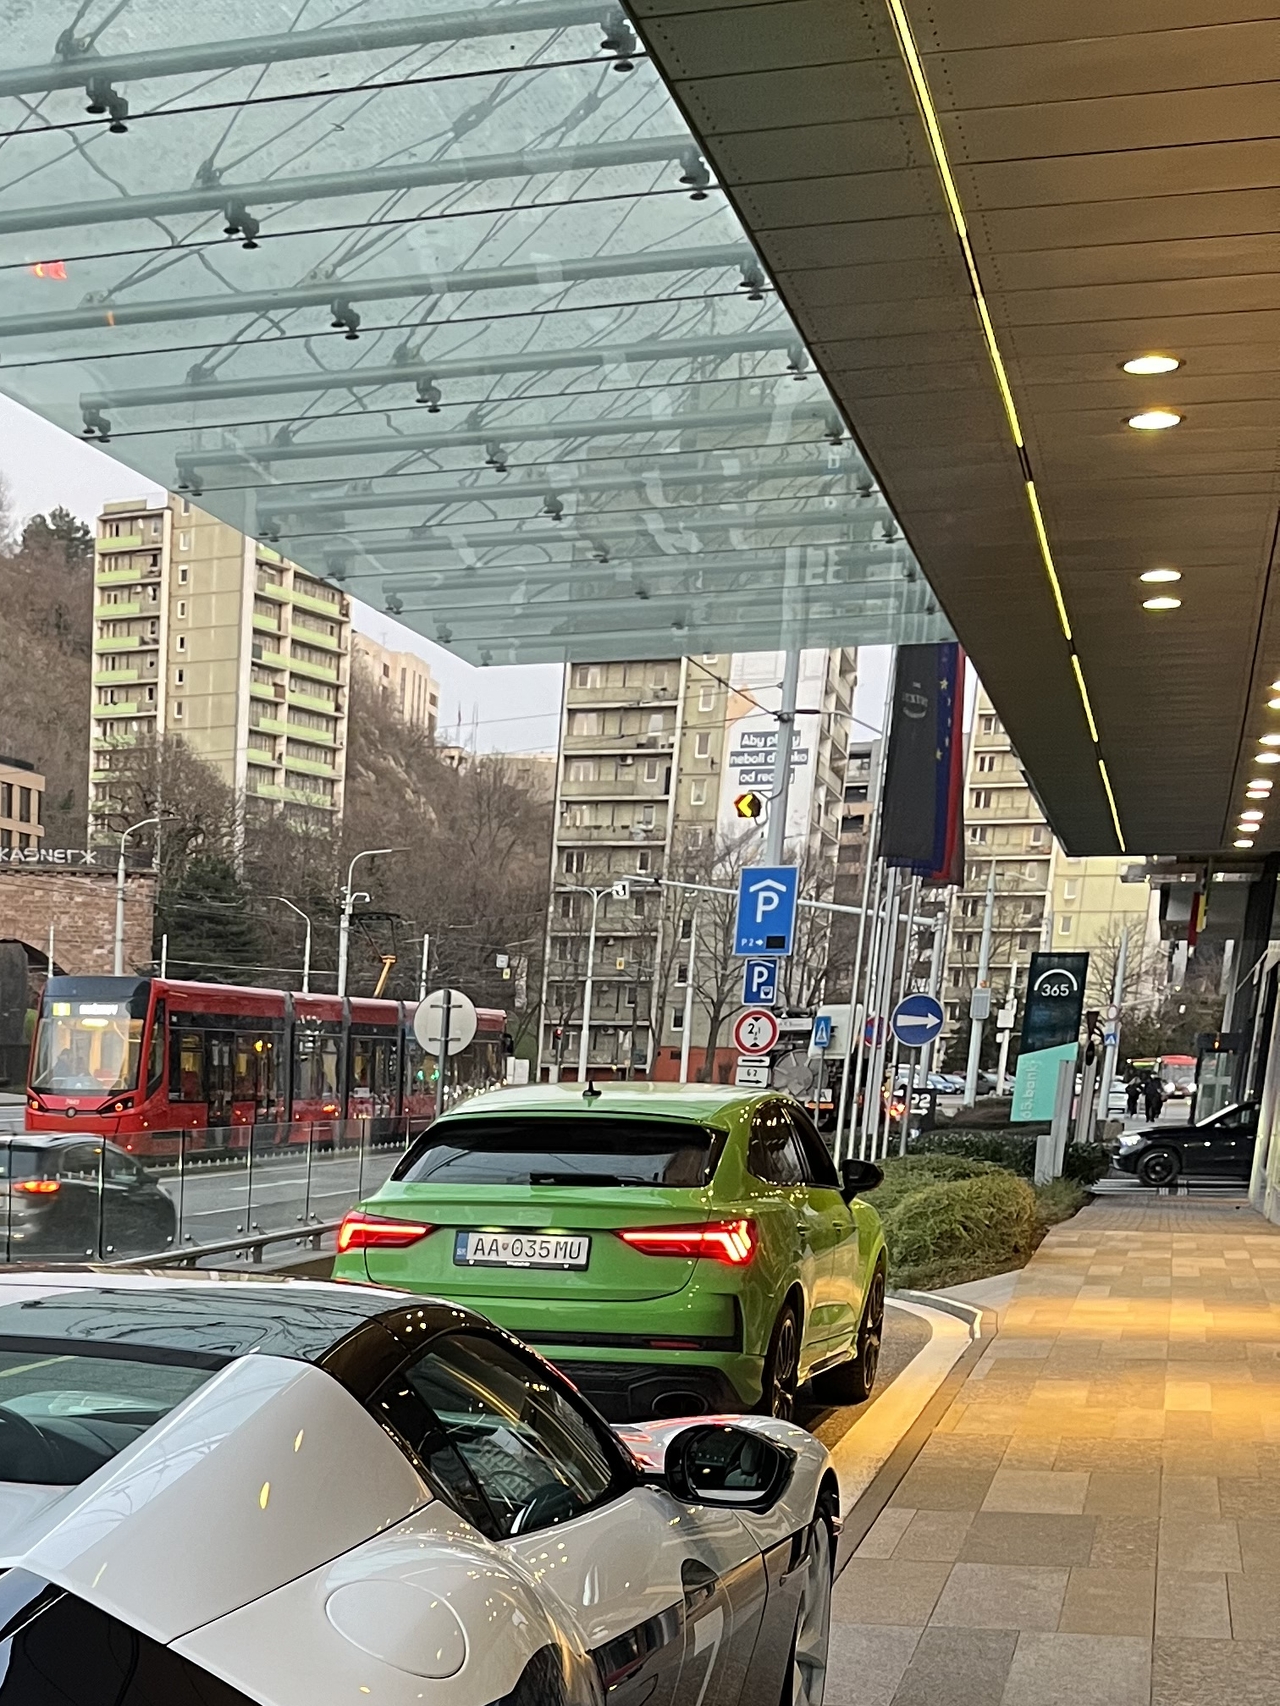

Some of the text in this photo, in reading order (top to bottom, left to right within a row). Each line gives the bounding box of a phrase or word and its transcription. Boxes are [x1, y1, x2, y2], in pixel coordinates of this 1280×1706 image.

[741, 734, 765, 747] Aby
[740, 771, 756, 783] od
[756, 891, 780, 923] P
[752, 966, 769, 992] P
[1041, 983, 1070, 997] 365
[473, 1237, 500, 1257] AA
